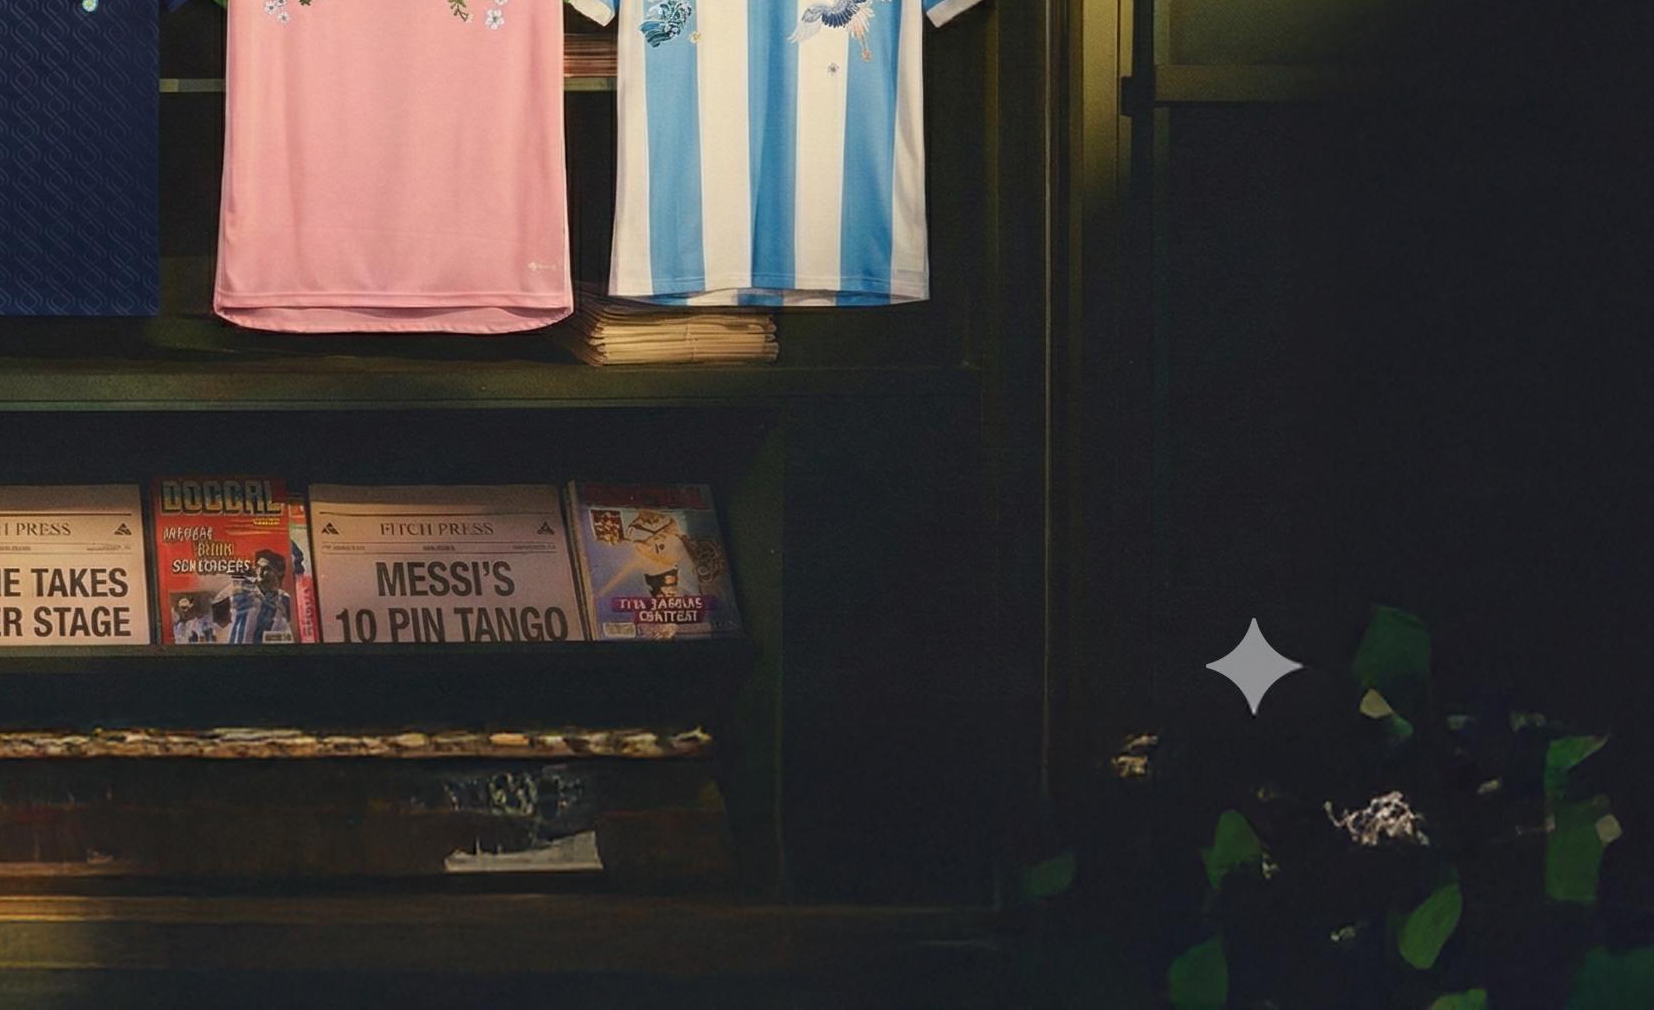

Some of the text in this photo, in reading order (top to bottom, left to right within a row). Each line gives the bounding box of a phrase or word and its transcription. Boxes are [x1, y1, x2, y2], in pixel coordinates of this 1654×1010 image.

[16, 522, 72, 536] PRESS
[438, 522, 494, 536] PRESS
[30, 567, 129, 598] TAKES
[375, 560, 516, 597] MESSI'S
[33, 606, 132, 638] STAGE
[335, 608, 378, 643] 10
[387, 607, 445, 643] PIN
[453, 606, 569, 642] TANGO
